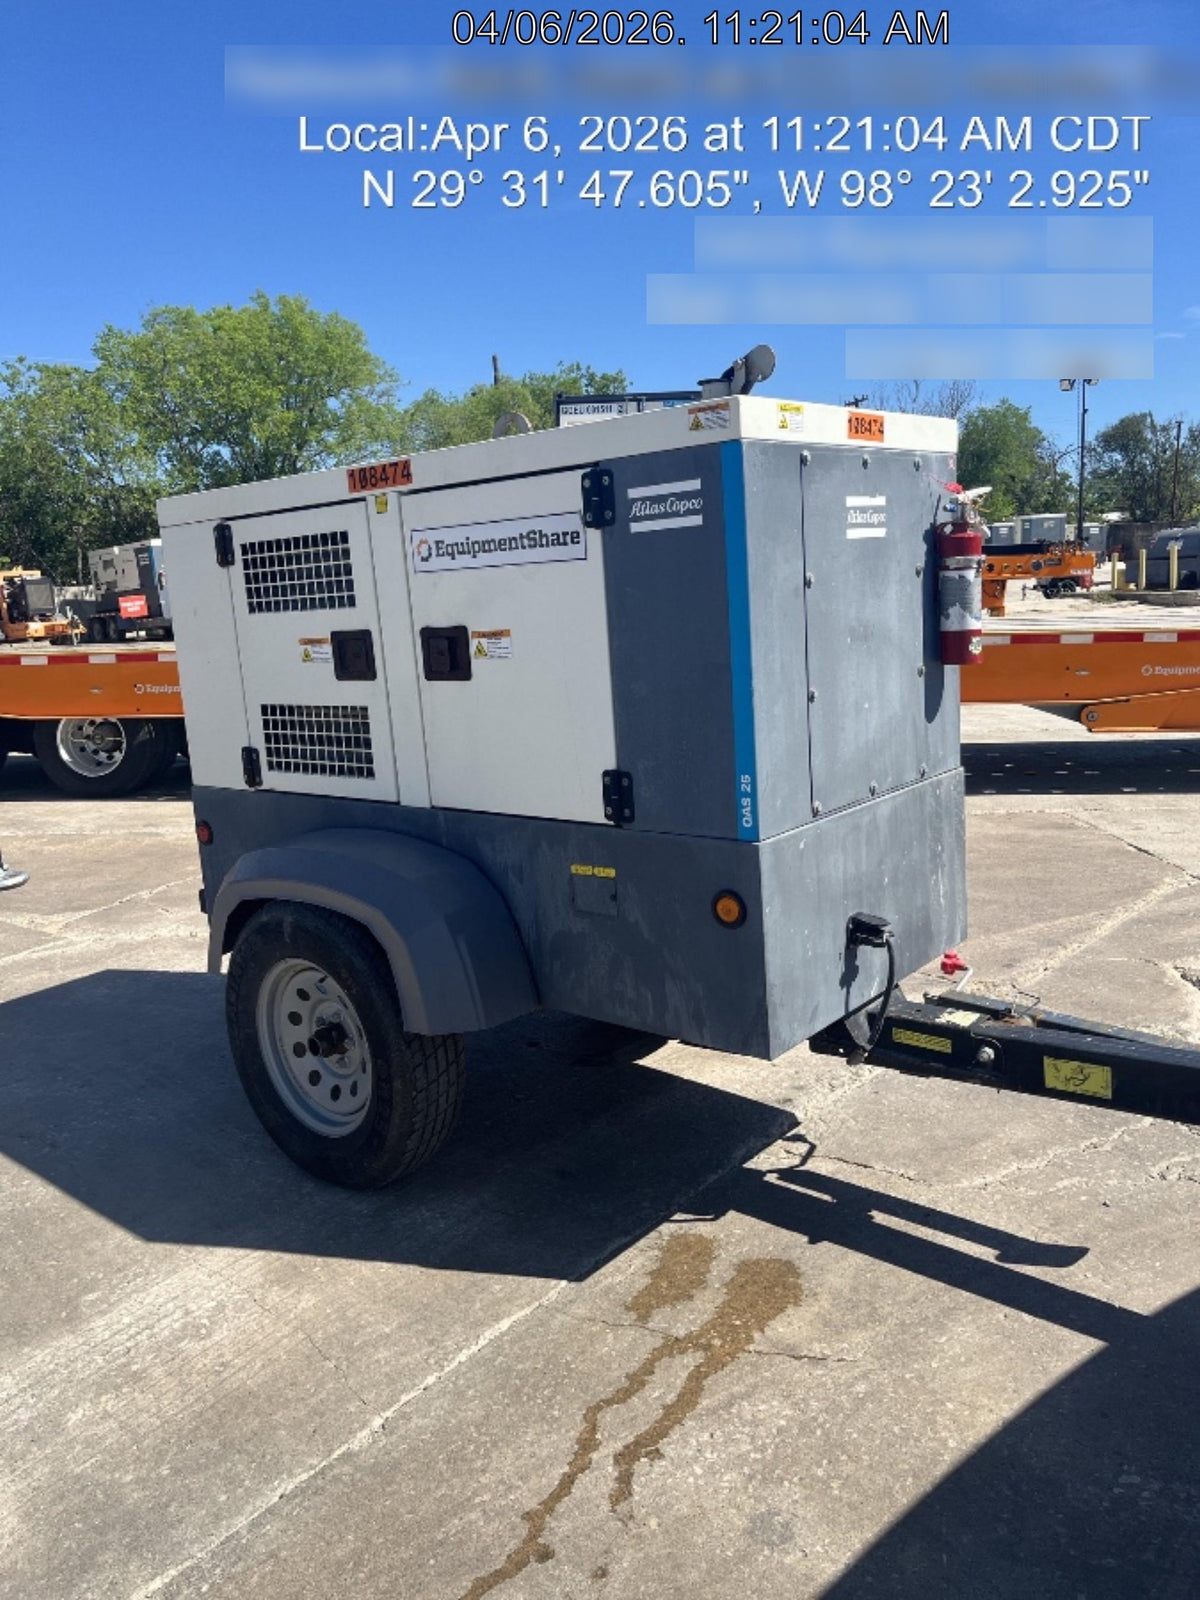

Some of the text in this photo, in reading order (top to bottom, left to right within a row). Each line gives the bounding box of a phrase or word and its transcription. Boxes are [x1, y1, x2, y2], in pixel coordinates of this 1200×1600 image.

[347, 459, 412, 490] 108474
[434, 529, 581, 560] EquipmentShare
[740, 774, 751, 793] 25
